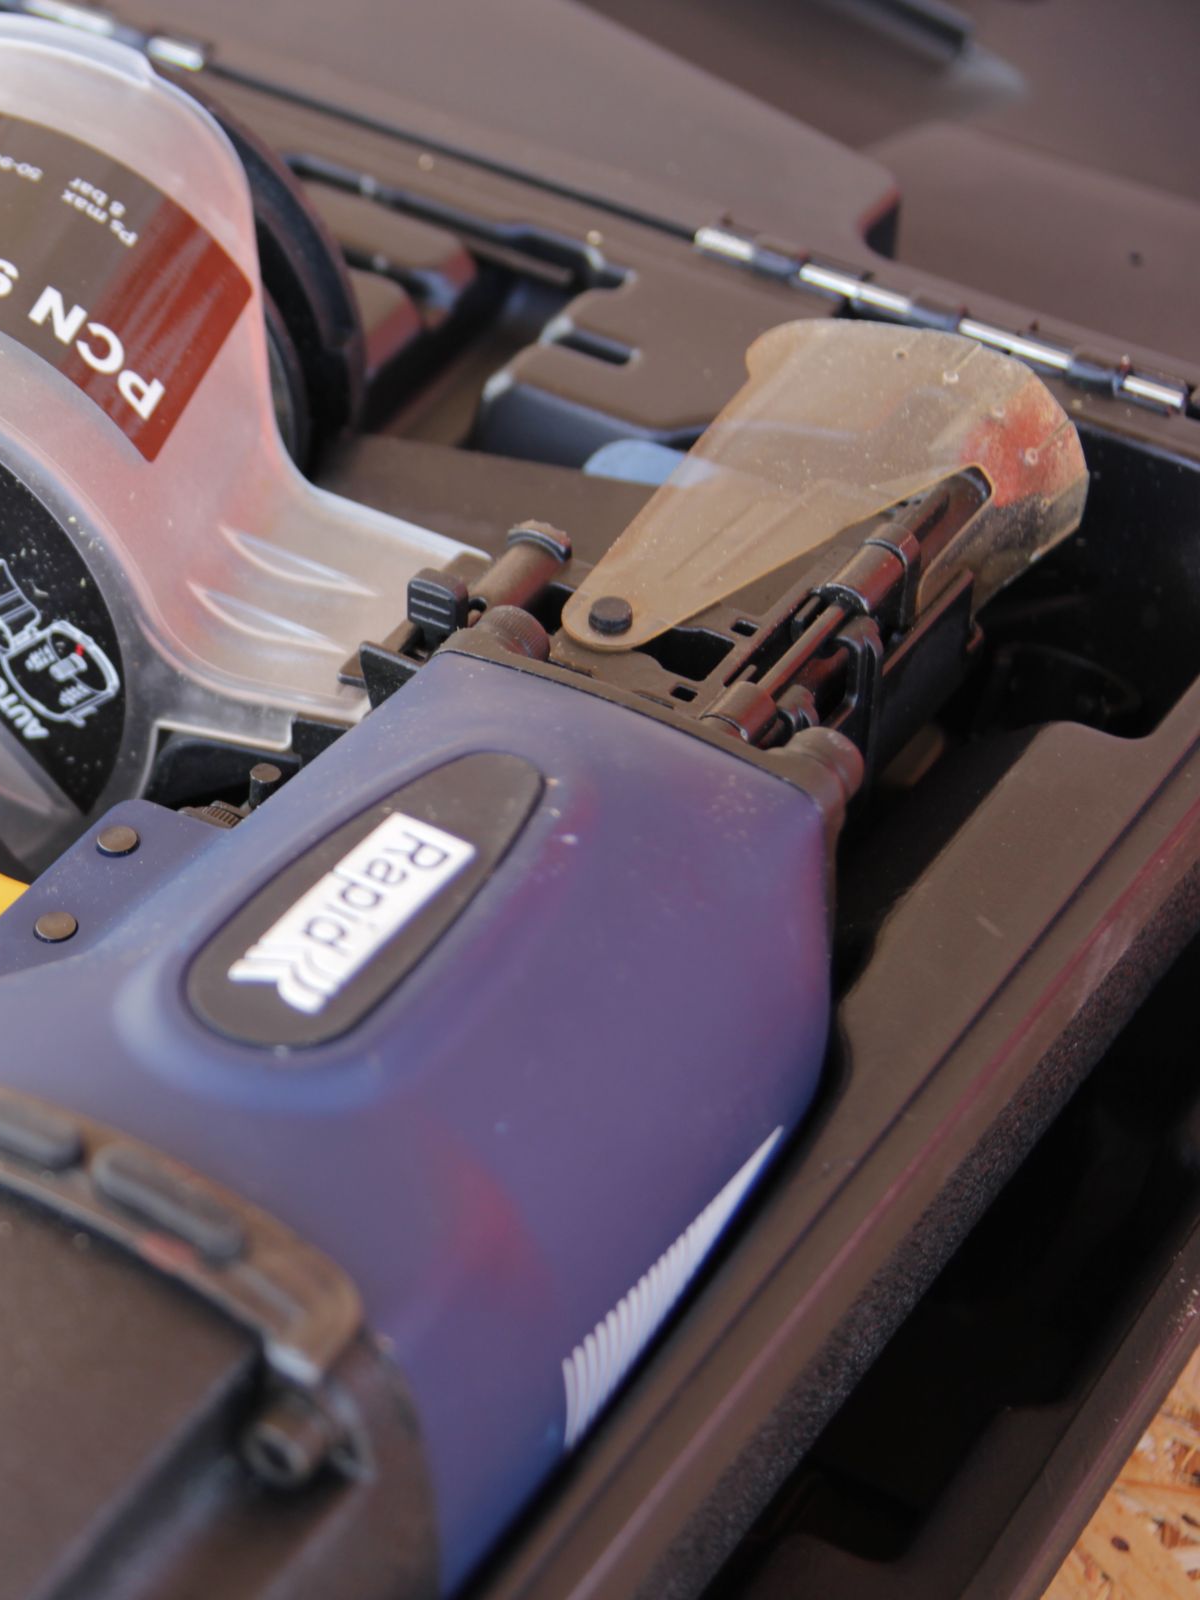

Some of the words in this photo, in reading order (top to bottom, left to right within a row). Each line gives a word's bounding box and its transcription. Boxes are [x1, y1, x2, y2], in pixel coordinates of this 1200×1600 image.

[62, 189, 109, 224] max
[69, 178, 108, 207] bar
[28, 286, 166, 420] PCN
[303, 831, 451, 956] Rapid
